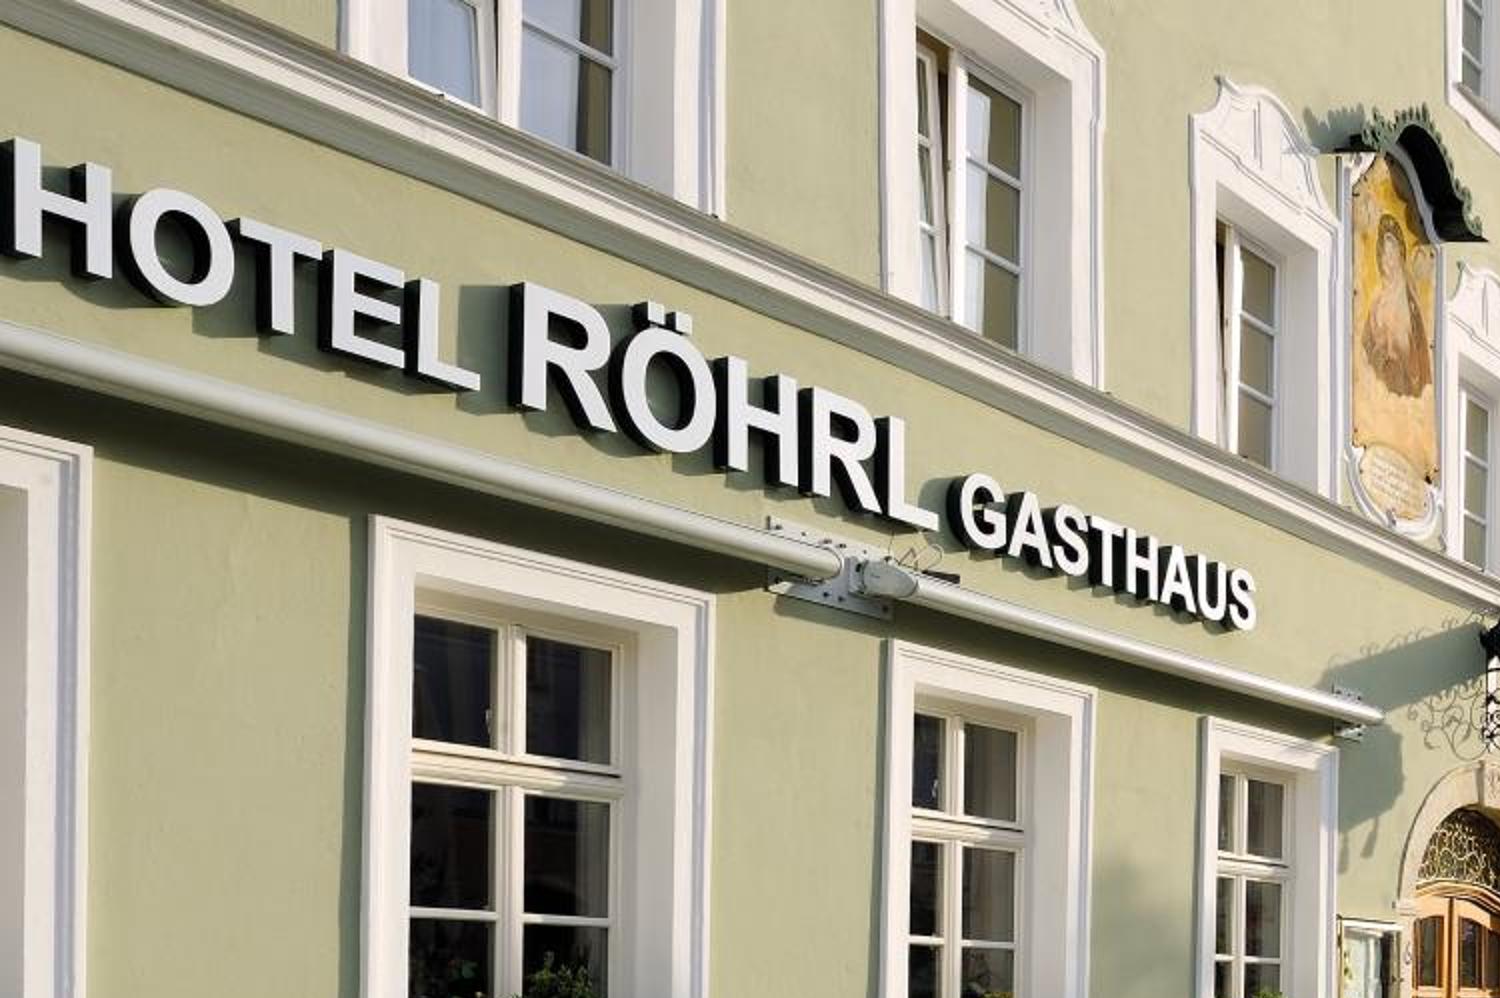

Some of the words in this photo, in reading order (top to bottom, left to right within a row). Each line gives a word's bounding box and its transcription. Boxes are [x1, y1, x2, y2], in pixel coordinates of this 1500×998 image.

[12, 136, 482, 392] HOTEL
[519, 281, 940, 533] RÖHRL
[957, 472, 1258, 632] GASTHAUS
